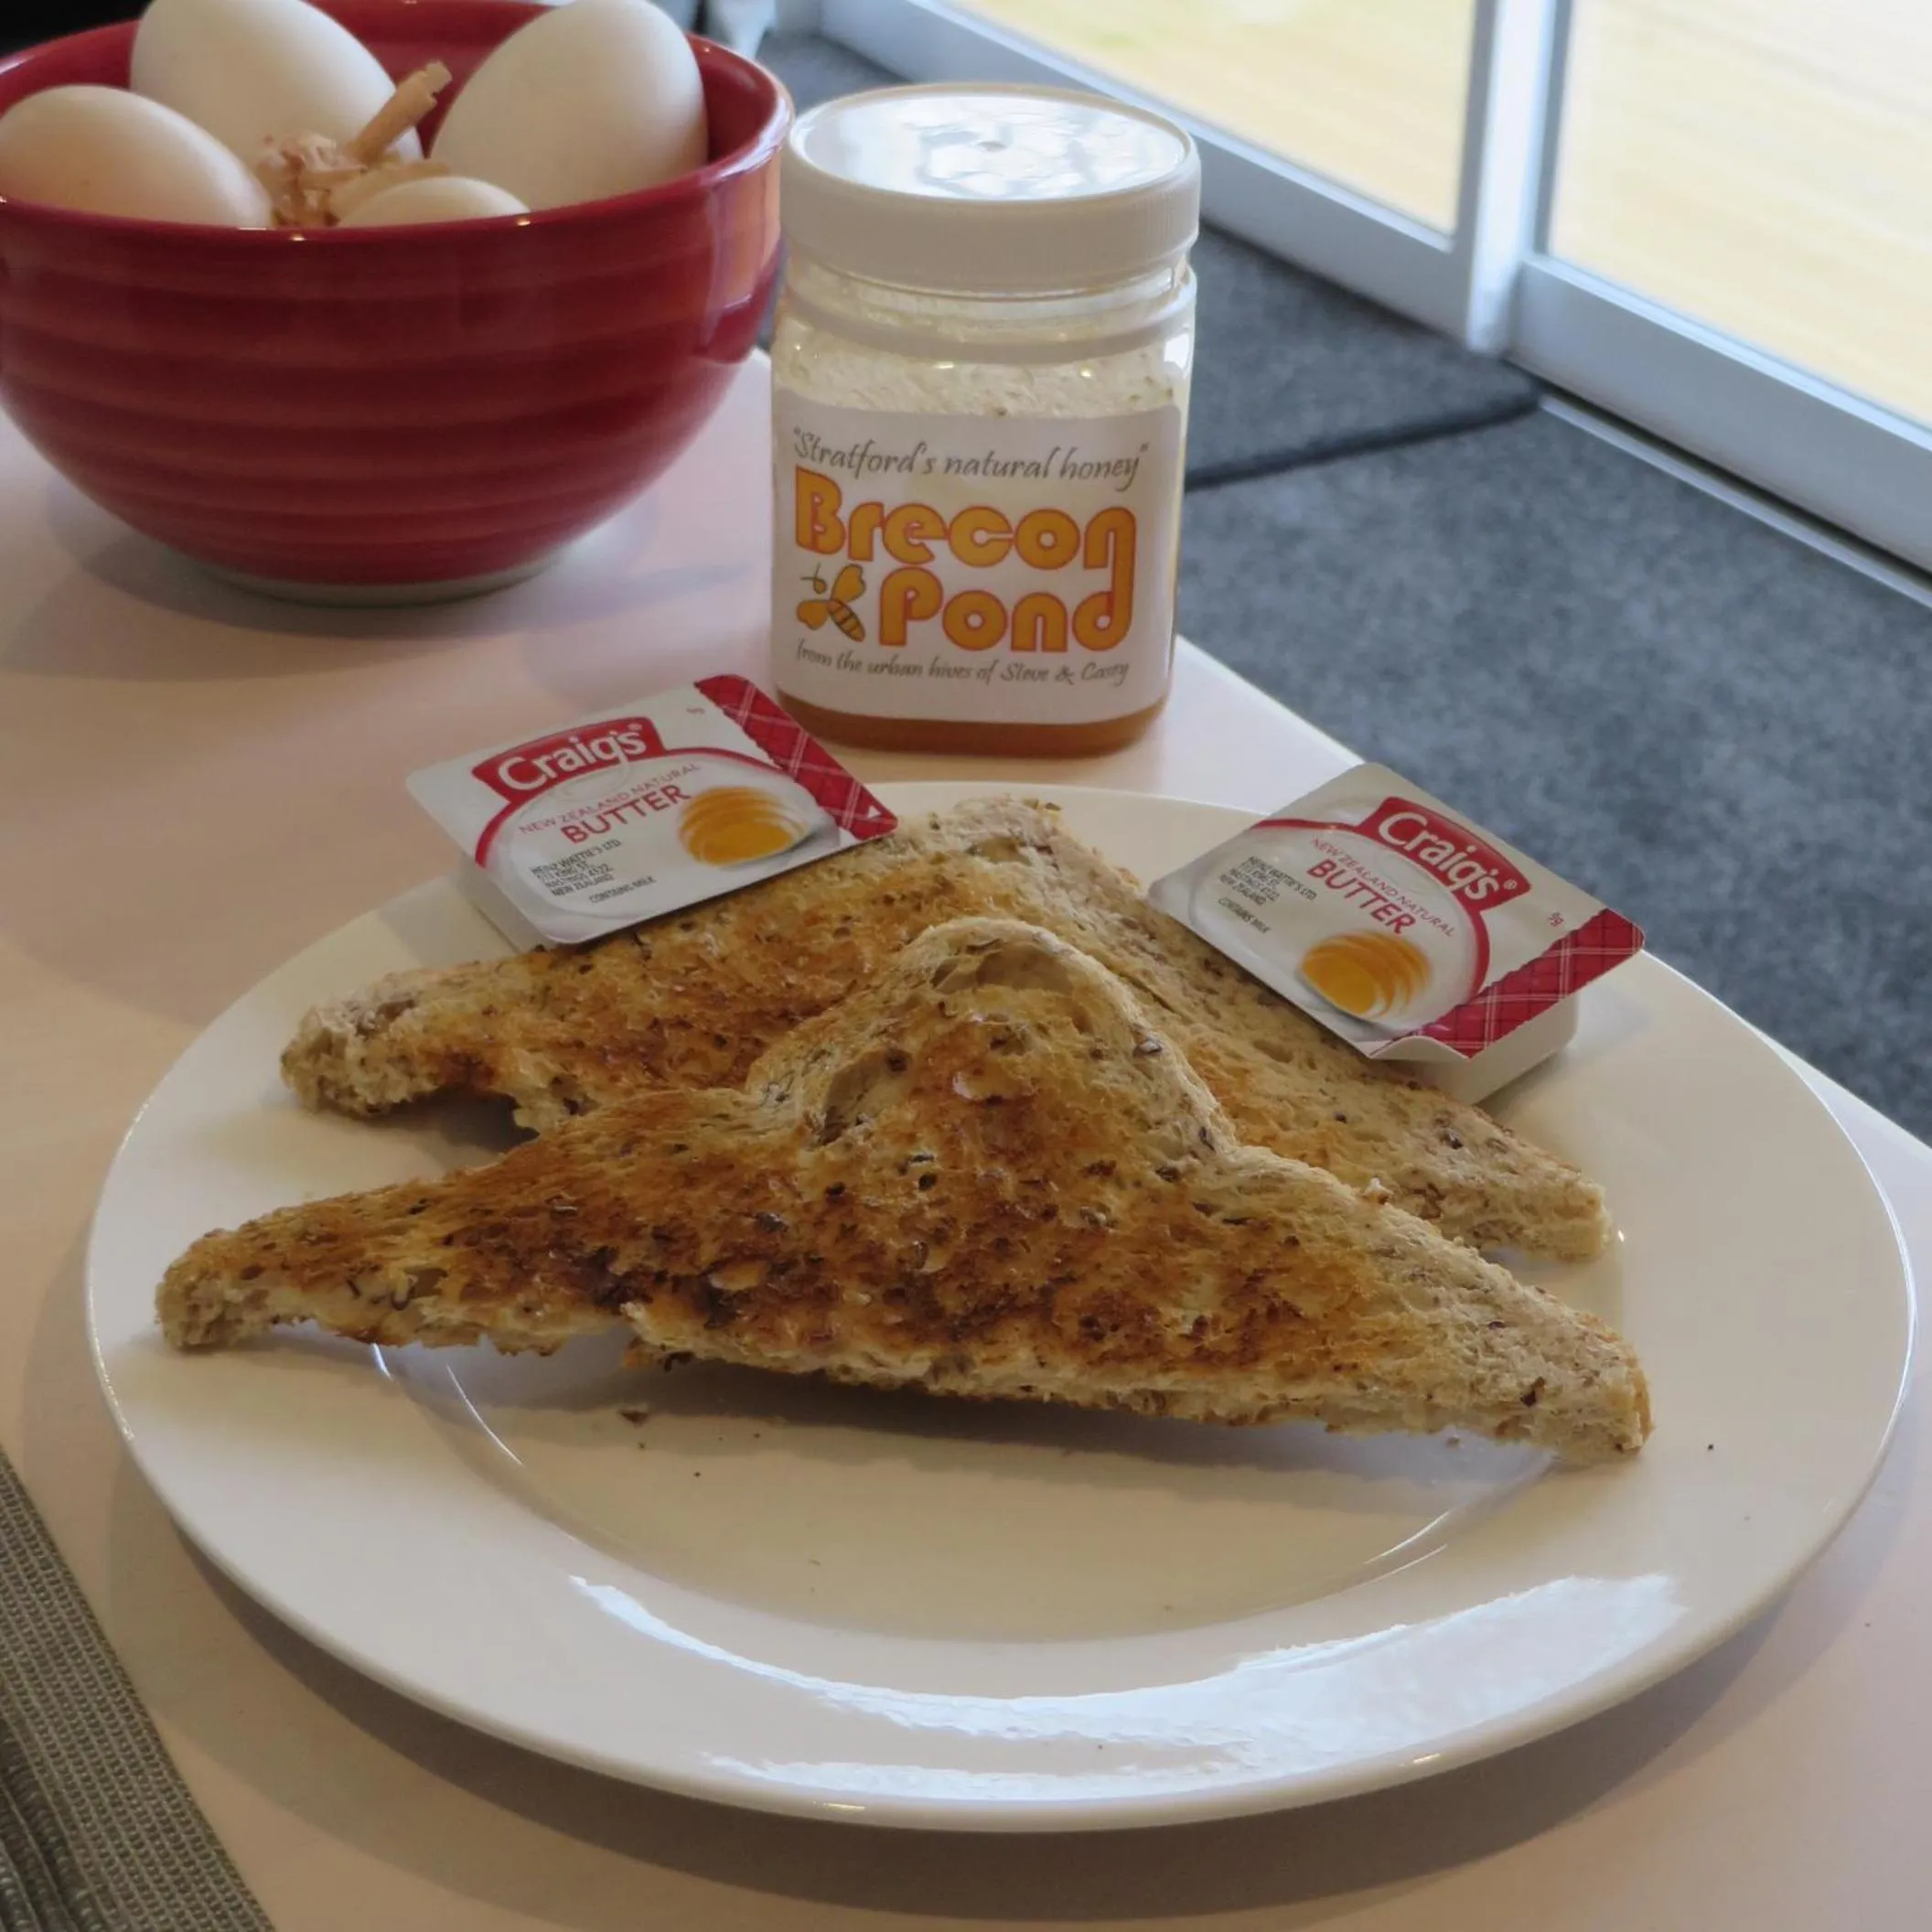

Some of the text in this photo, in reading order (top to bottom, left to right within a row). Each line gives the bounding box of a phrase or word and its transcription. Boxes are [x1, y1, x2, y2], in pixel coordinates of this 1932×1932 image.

[943, 446, 1060, 479] natural
[795, 464, 1137, 570] Brecon
[879, 564, 1136, 652] Pond
[797, 639, 832, 668] from
[837, 649, 863, 672] the
[867, 653, 923, 678] urban
[928, 655, 971, 680] hives
[976, 659, 1000, 686] of
[1000, 661, 1050, 682] Steve
[1055, 663, 1076, 686] &
[518, 762, 703, 834] NEW ZEALAND NATURAL
[560, 783, 692, 844] BUTTER
[1306, 858, 1417, 936] BUTTER
[1311, 837, 1455, 938] NEW ZEALAND NATURAL
